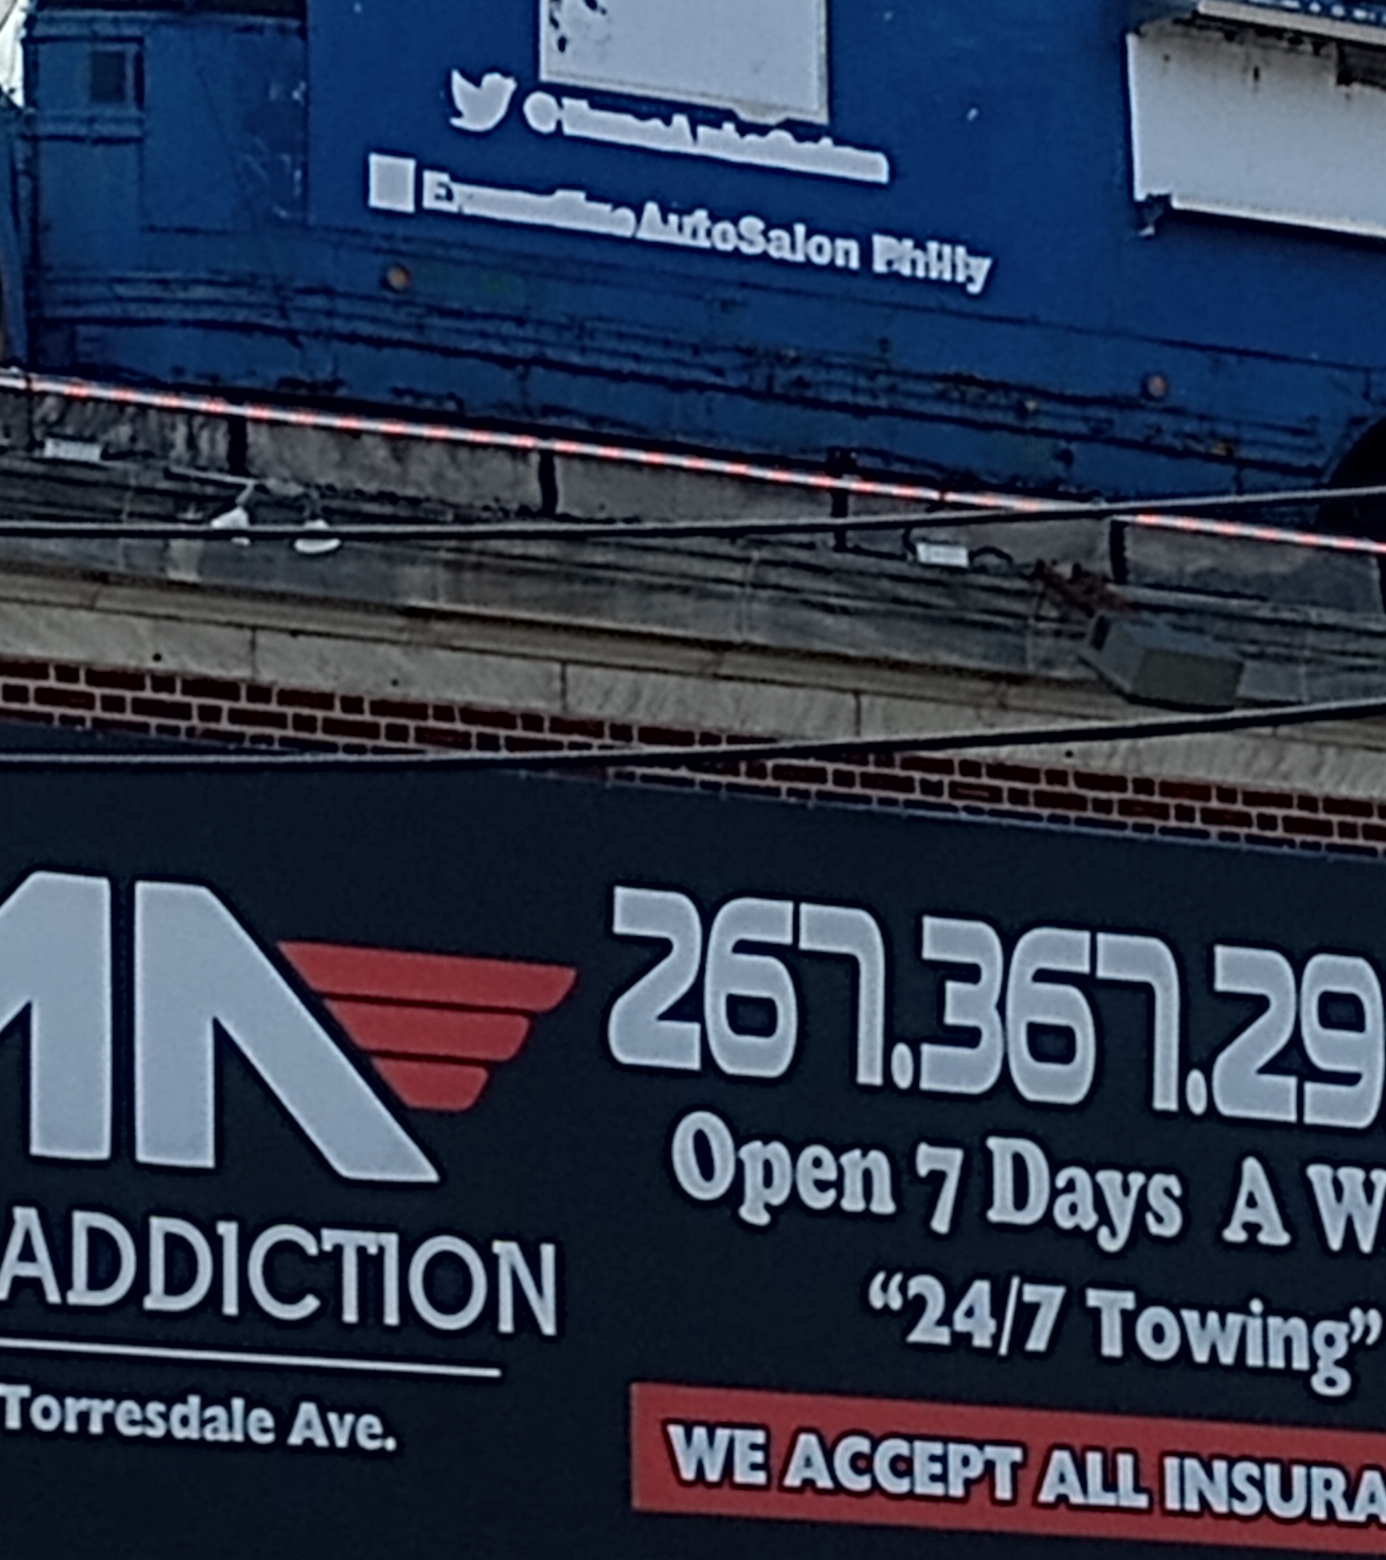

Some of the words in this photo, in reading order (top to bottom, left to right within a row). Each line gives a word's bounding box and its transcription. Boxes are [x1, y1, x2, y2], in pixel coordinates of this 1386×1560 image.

[871, 233, 993, 294] Philly
[672, 1111, 896, 1226] Open
[916, 1142, 964, 1234] 7
[986, 1136, 1182, 1252] Days
[1222, 1156, 1291, 1246] A
[287, 1402, 396, 1451] Ave.
[667, 1424, 767, 1485] WE
[783, 1433, 1023, 1500] ACCEPT
[1038, 1450, 1149, 1508] ALL
